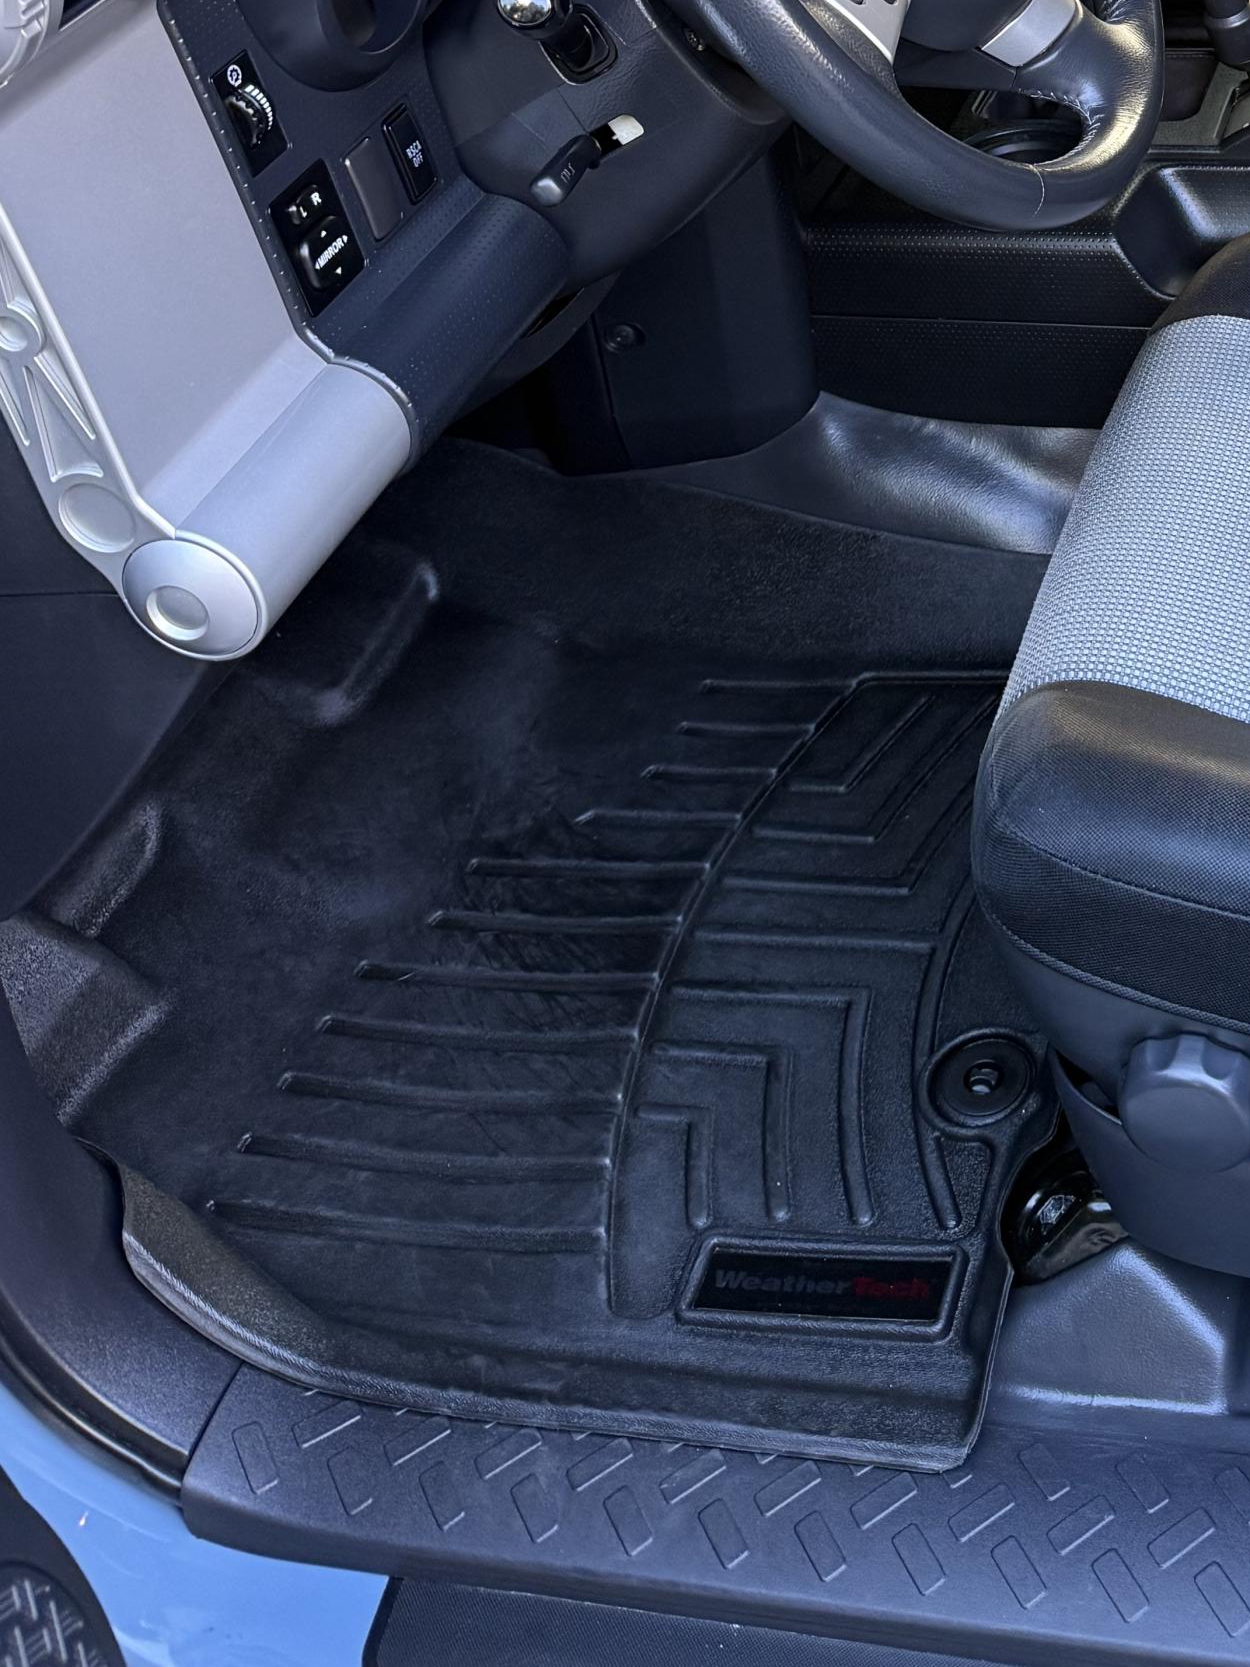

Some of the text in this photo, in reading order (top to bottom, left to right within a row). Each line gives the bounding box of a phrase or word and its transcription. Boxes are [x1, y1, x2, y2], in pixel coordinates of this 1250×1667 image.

[299, 191, 322, 218] L R
[318, 237, 345, 268] MIRROR
[714, 1268, 930, 1301] WeatherTech
